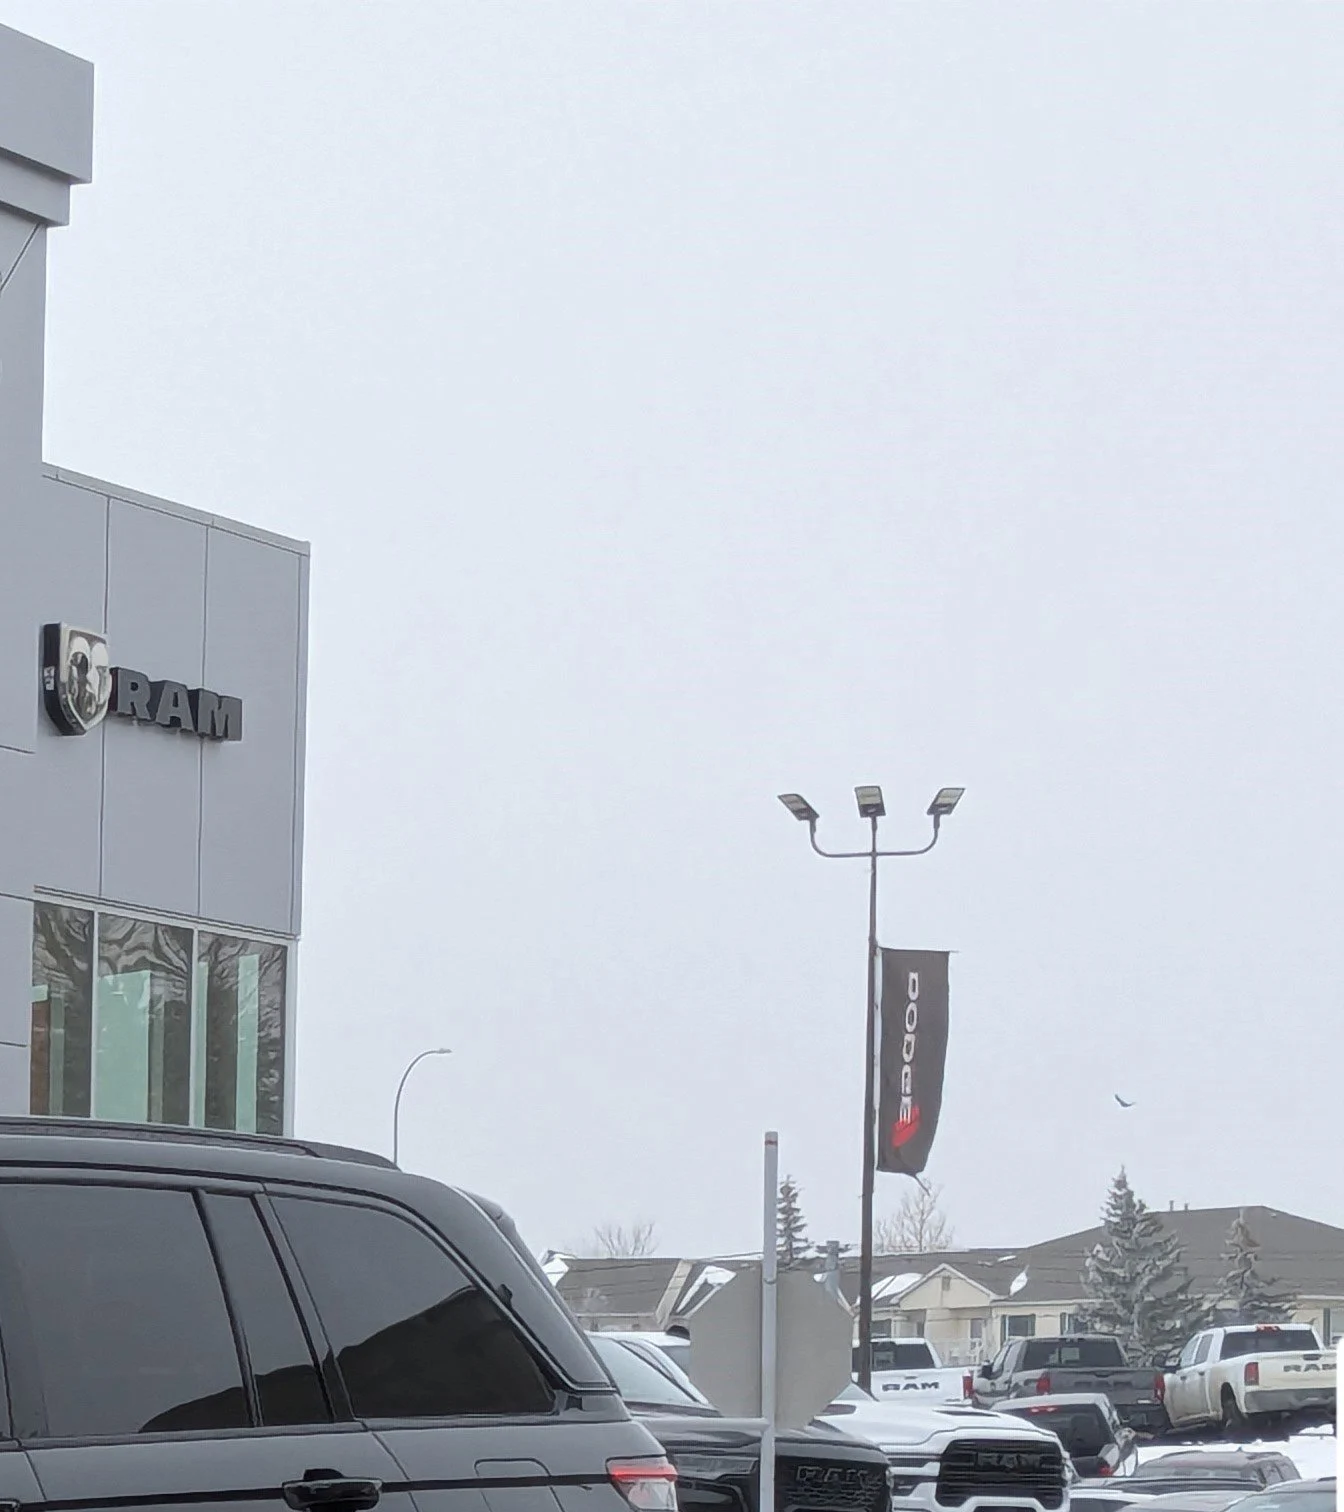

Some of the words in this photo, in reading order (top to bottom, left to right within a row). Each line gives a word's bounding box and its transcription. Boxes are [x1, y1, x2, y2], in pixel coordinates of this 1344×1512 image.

[109, 666, 243, 742] RAM
[899, 971, 920, 1125] DODGE
[881, 1381, 940, 1392] RAM
